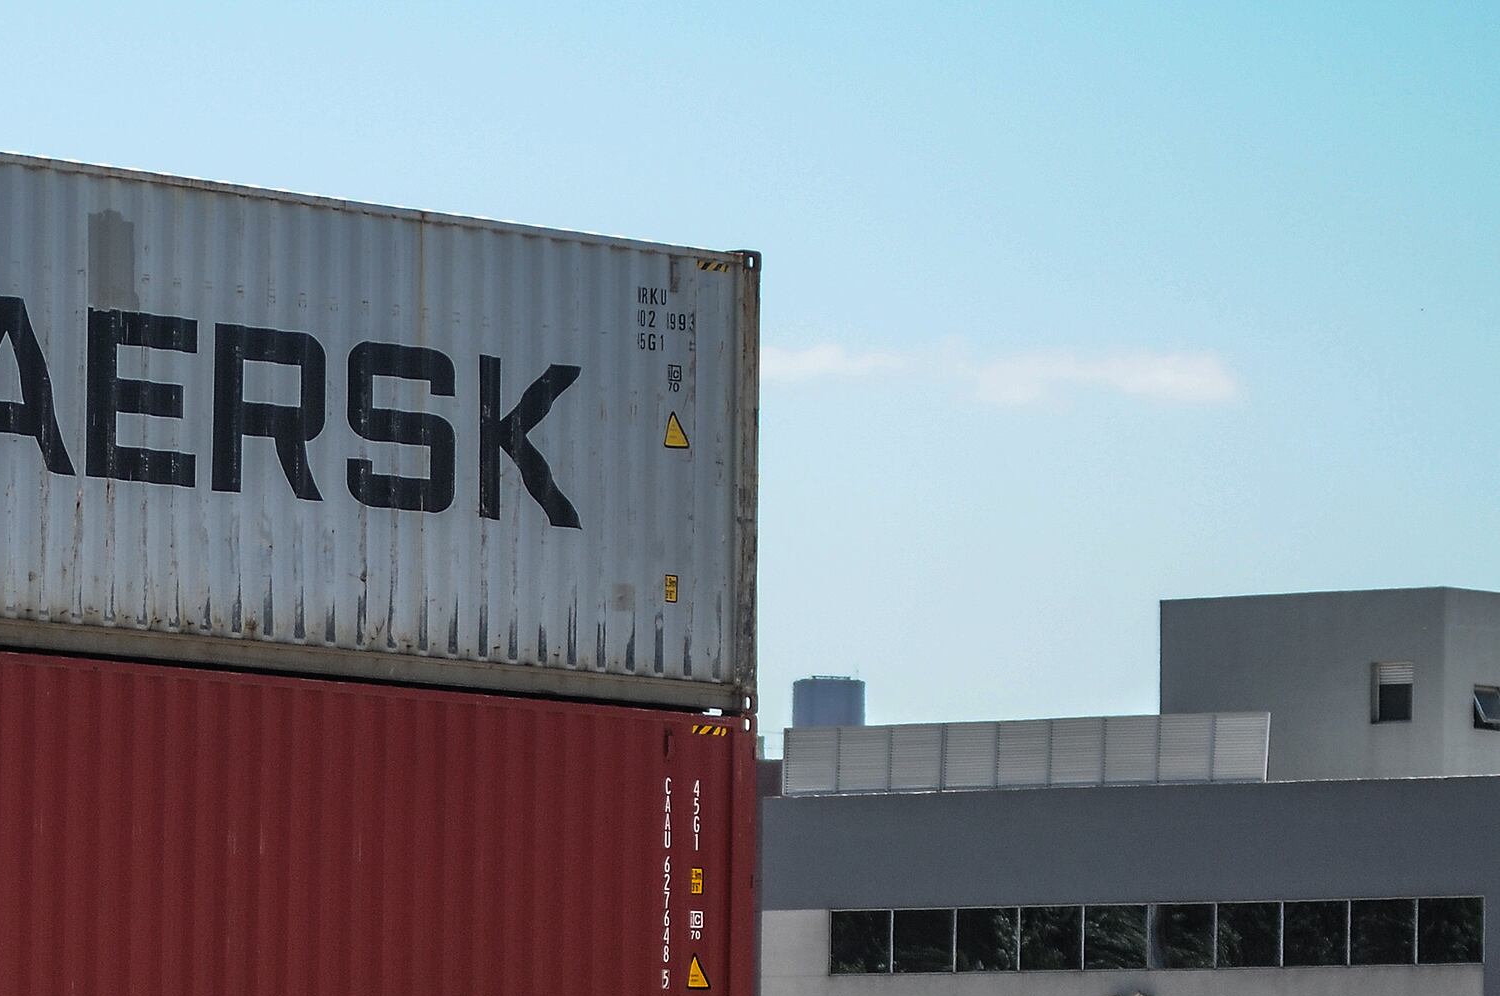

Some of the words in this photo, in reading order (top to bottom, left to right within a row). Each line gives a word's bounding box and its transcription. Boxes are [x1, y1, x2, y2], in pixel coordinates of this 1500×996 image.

[664, 777, 672, 849] CAAU
[693, 779, 701, 851] 45G1
[663, 856, 671, 963] 627648
[690, 930, 701, 940] 70
[662, 969, 670, 989] 5
